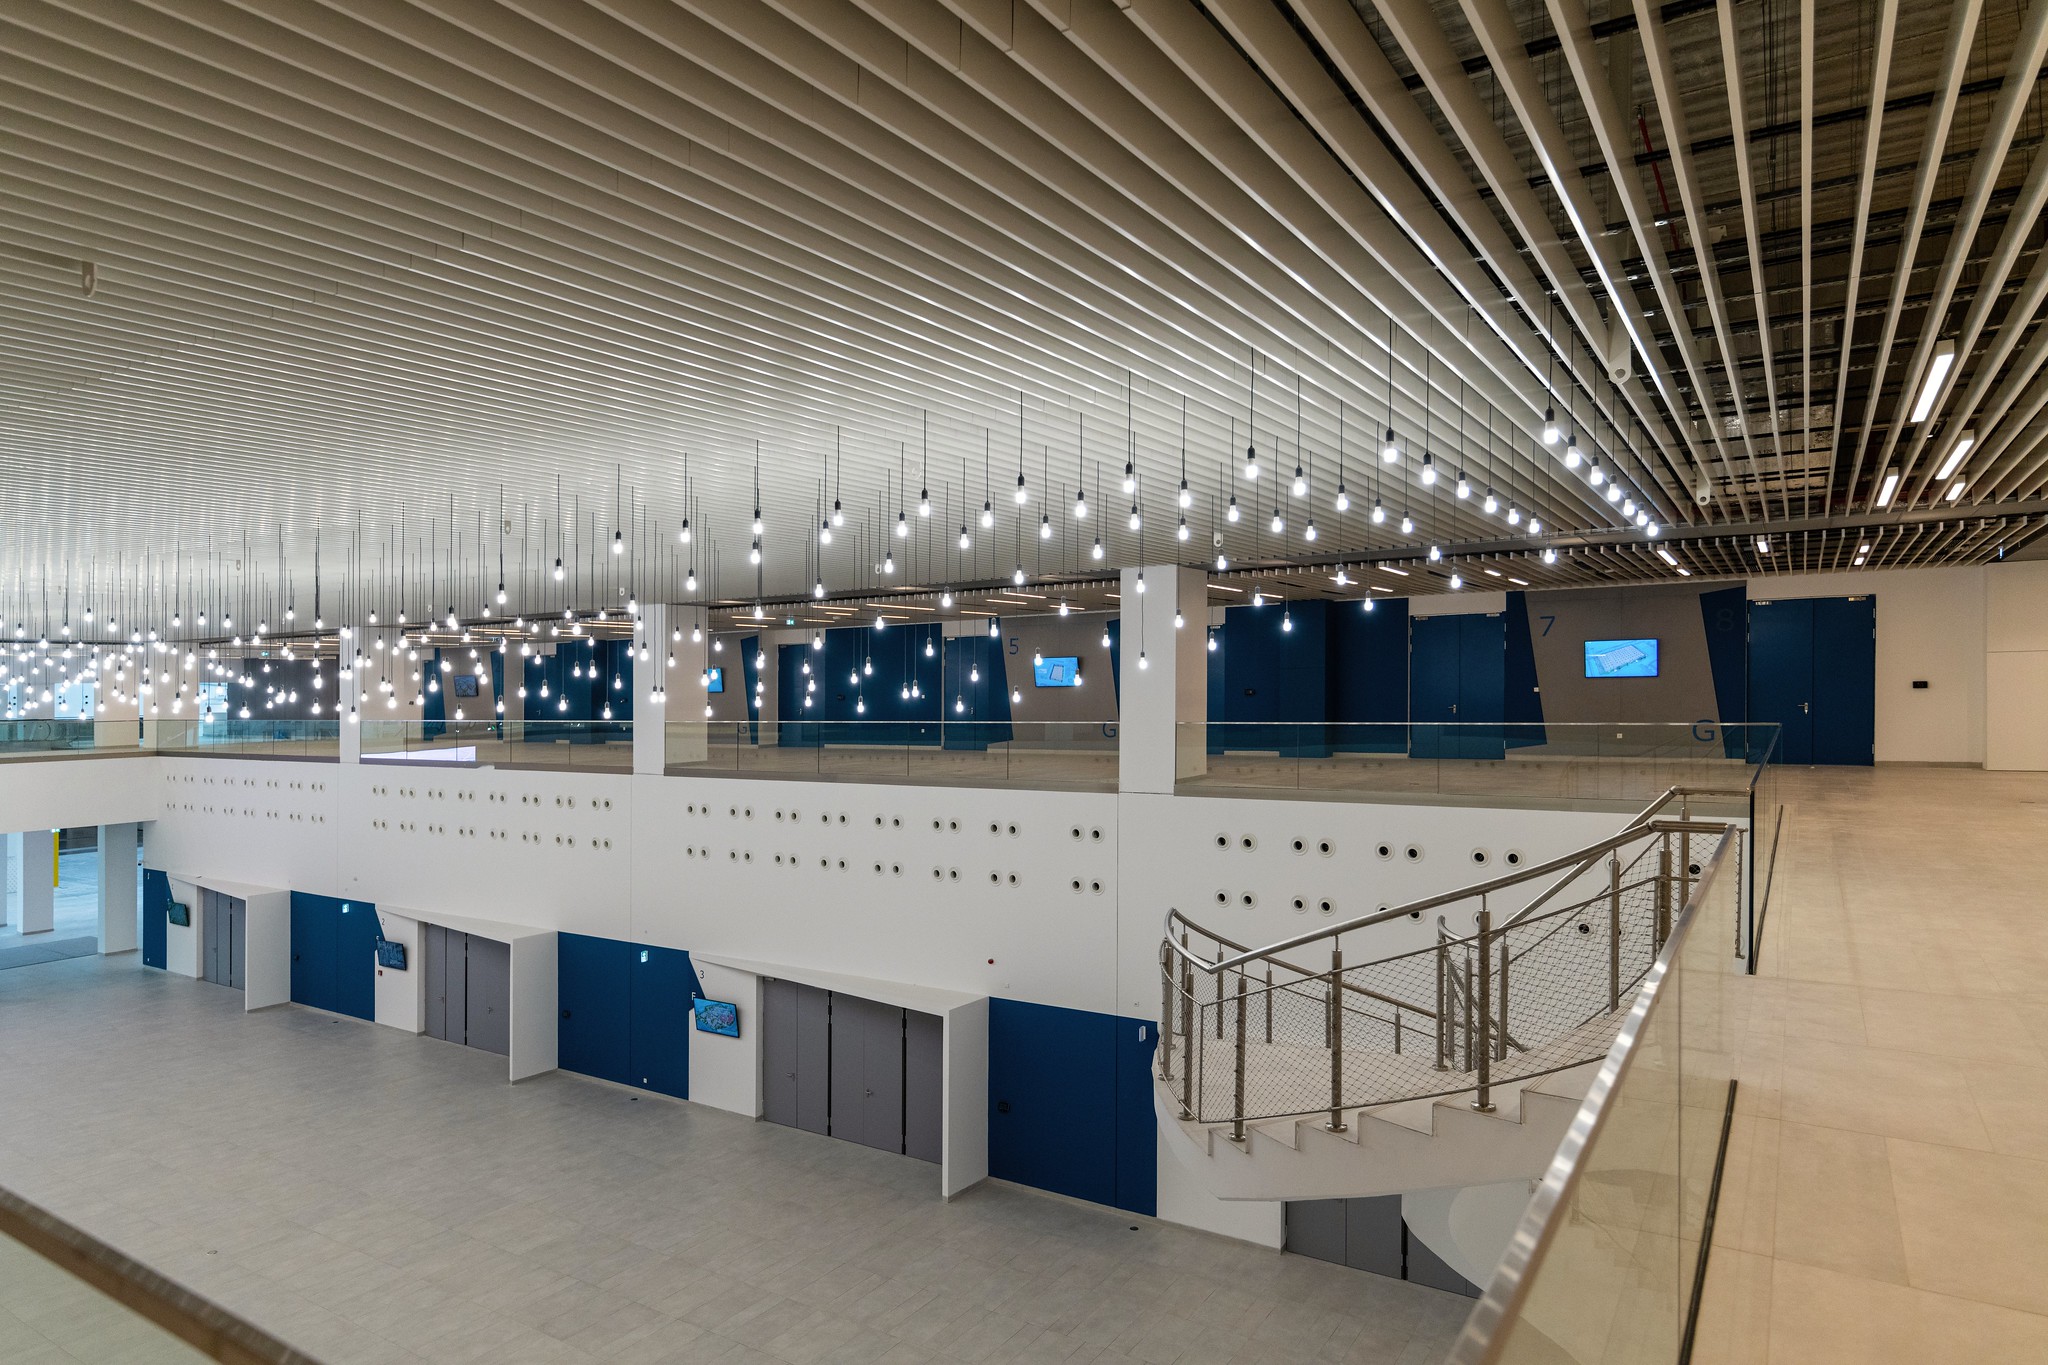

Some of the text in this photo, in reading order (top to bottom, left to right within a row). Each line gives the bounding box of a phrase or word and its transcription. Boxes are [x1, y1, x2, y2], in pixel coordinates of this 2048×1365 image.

[1540, 616, 1555, 637] 7
[1009, 638, 1019, 655] 5
[1102, 719, 1117, 738] G
[1692, 719, 1715, 742] G
[381, 917, 386, 926] 2
[699, 969, 705, 980] 3
